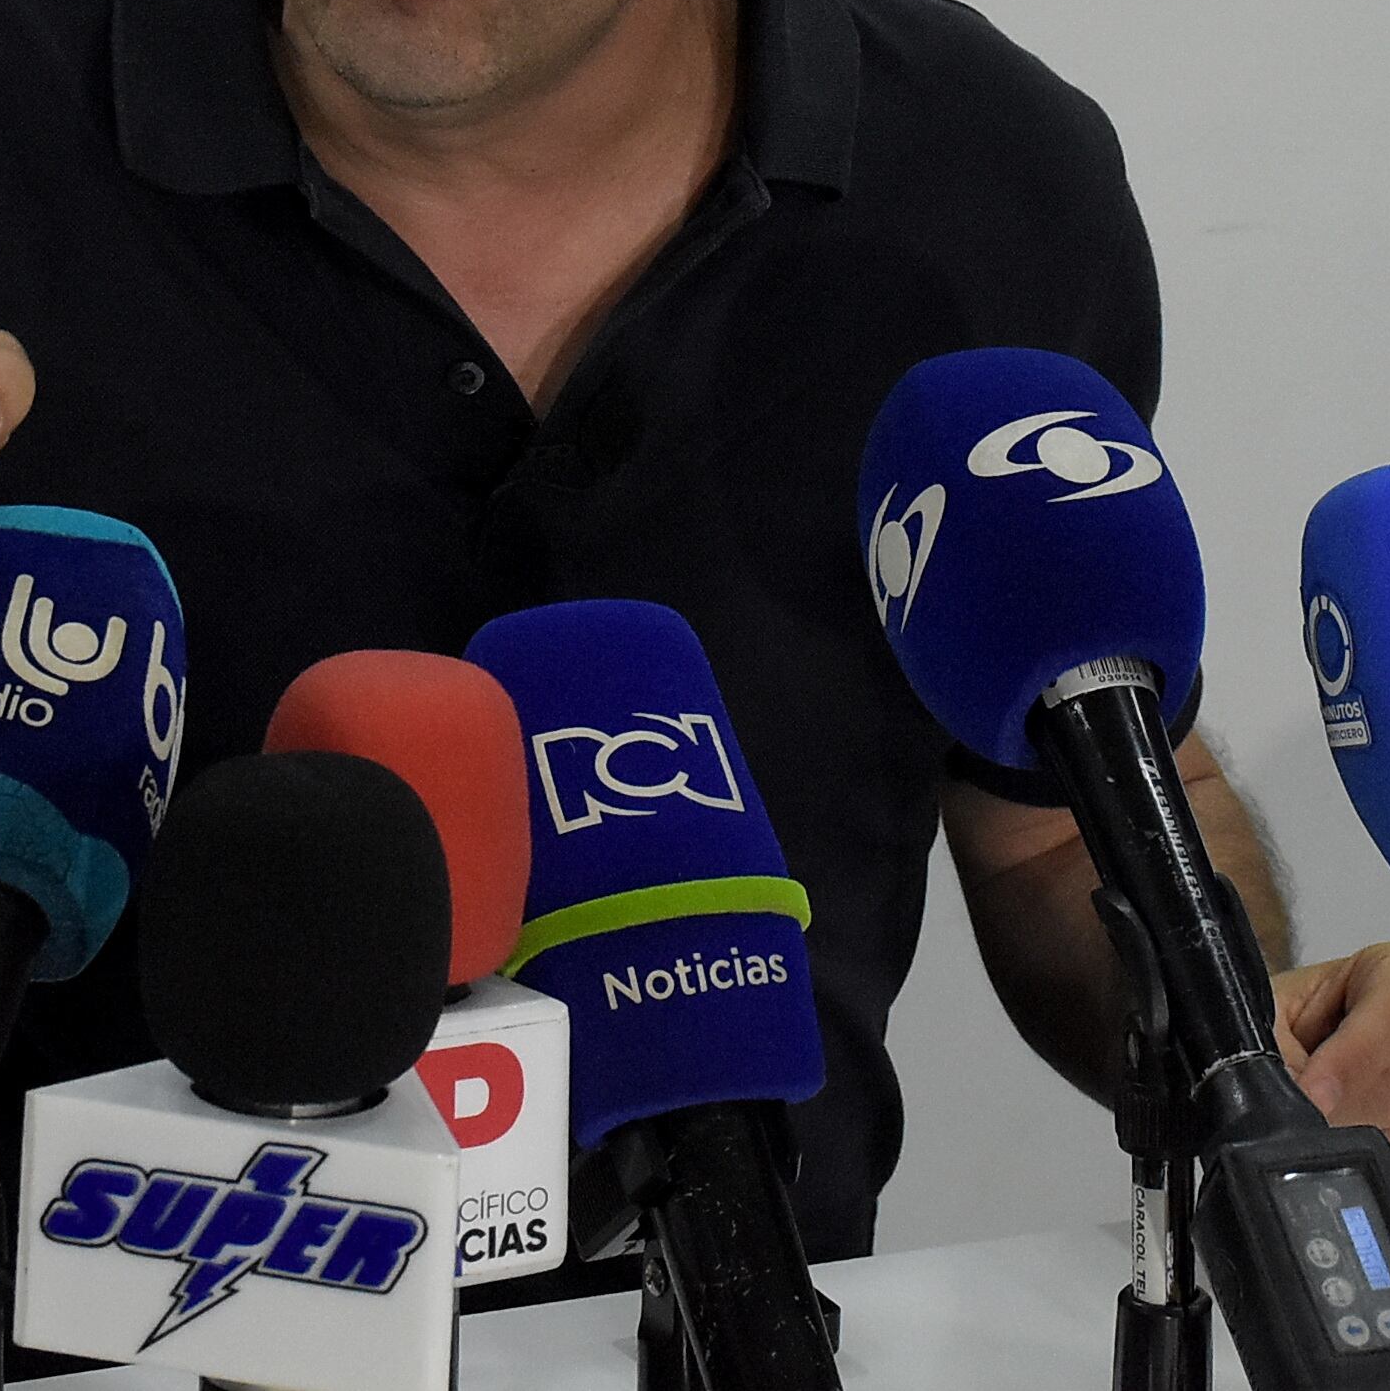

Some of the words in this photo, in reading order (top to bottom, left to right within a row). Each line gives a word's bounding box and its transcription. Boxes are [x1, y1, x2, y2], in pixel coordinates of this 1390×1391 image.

[1309, 594, 1351, 696] 0
[532, 712, 745, 835] RCN
[603, 947, 788, 1010] Noticias
[40, 1156, 428, 1297] SUPER
[459, 1187, 549, 1222] CÍFICO
[1135, 1187, 1146, 1264] CARACOL
[458, 1218, 548, 1263] CIAS
[1136, 1269, 1146, 1297] TEL
